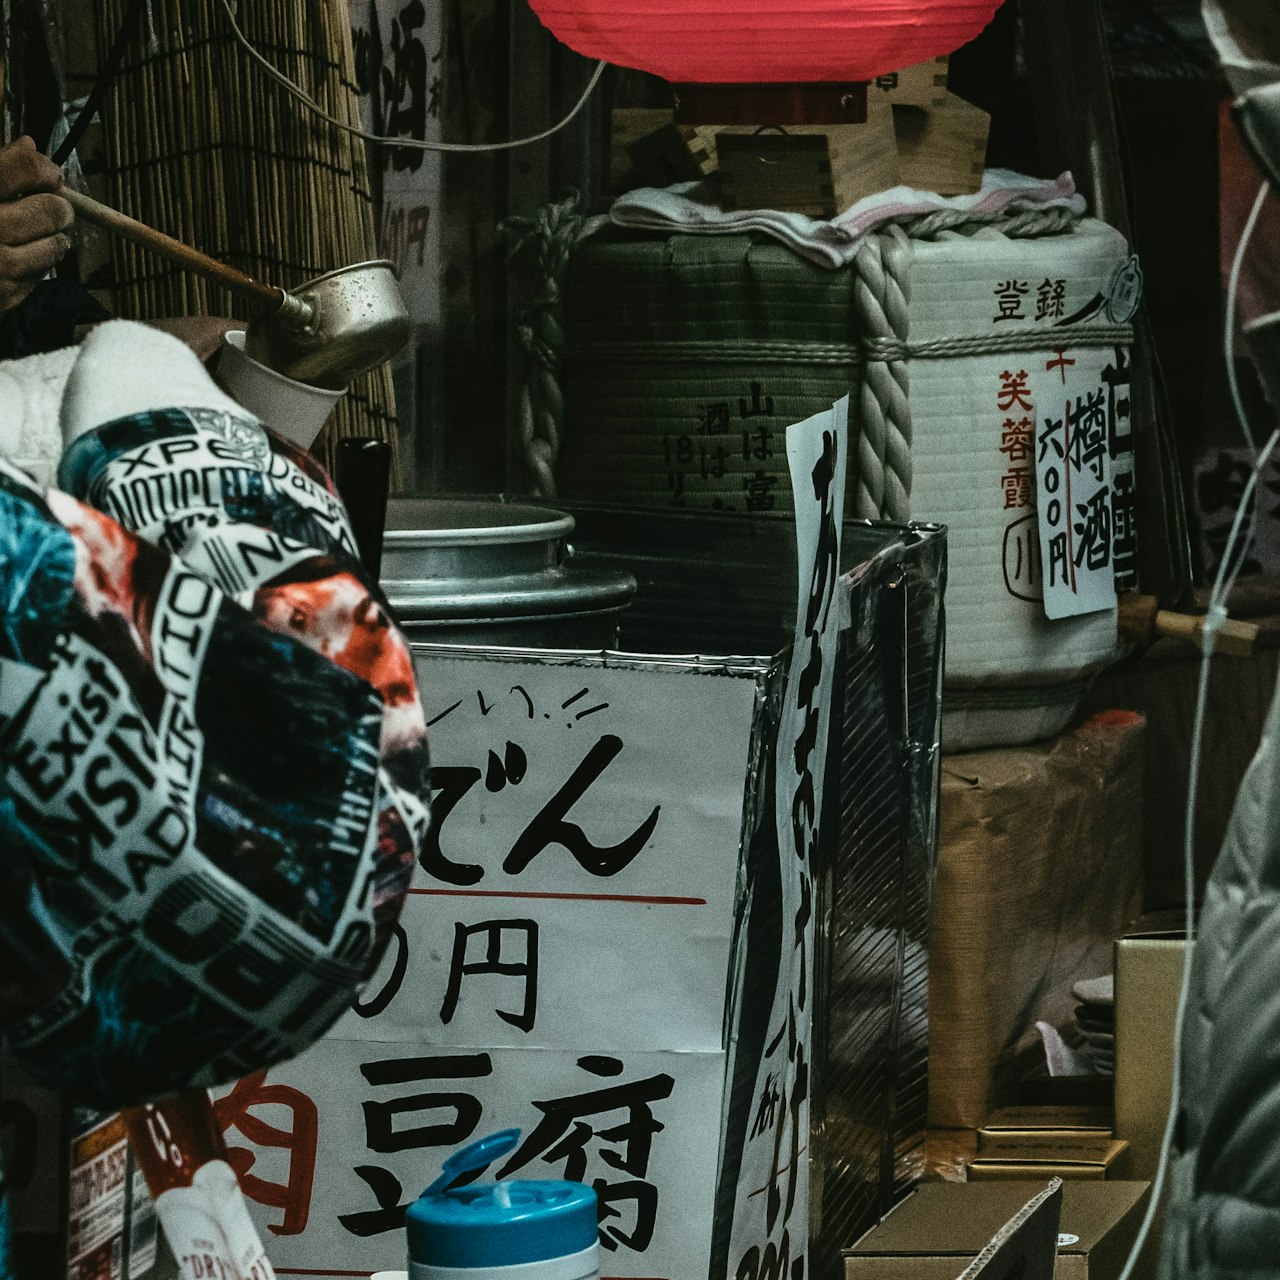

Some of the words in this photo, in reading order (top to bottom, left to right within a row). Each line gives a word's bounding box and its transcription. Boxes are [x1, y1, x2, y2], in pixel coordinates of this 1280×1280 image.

[107, 467, 220, 531] NOTICE
[697, 402, 737, 511] 酒は
[212, 1052, 676, 1254] 肉豆腐
